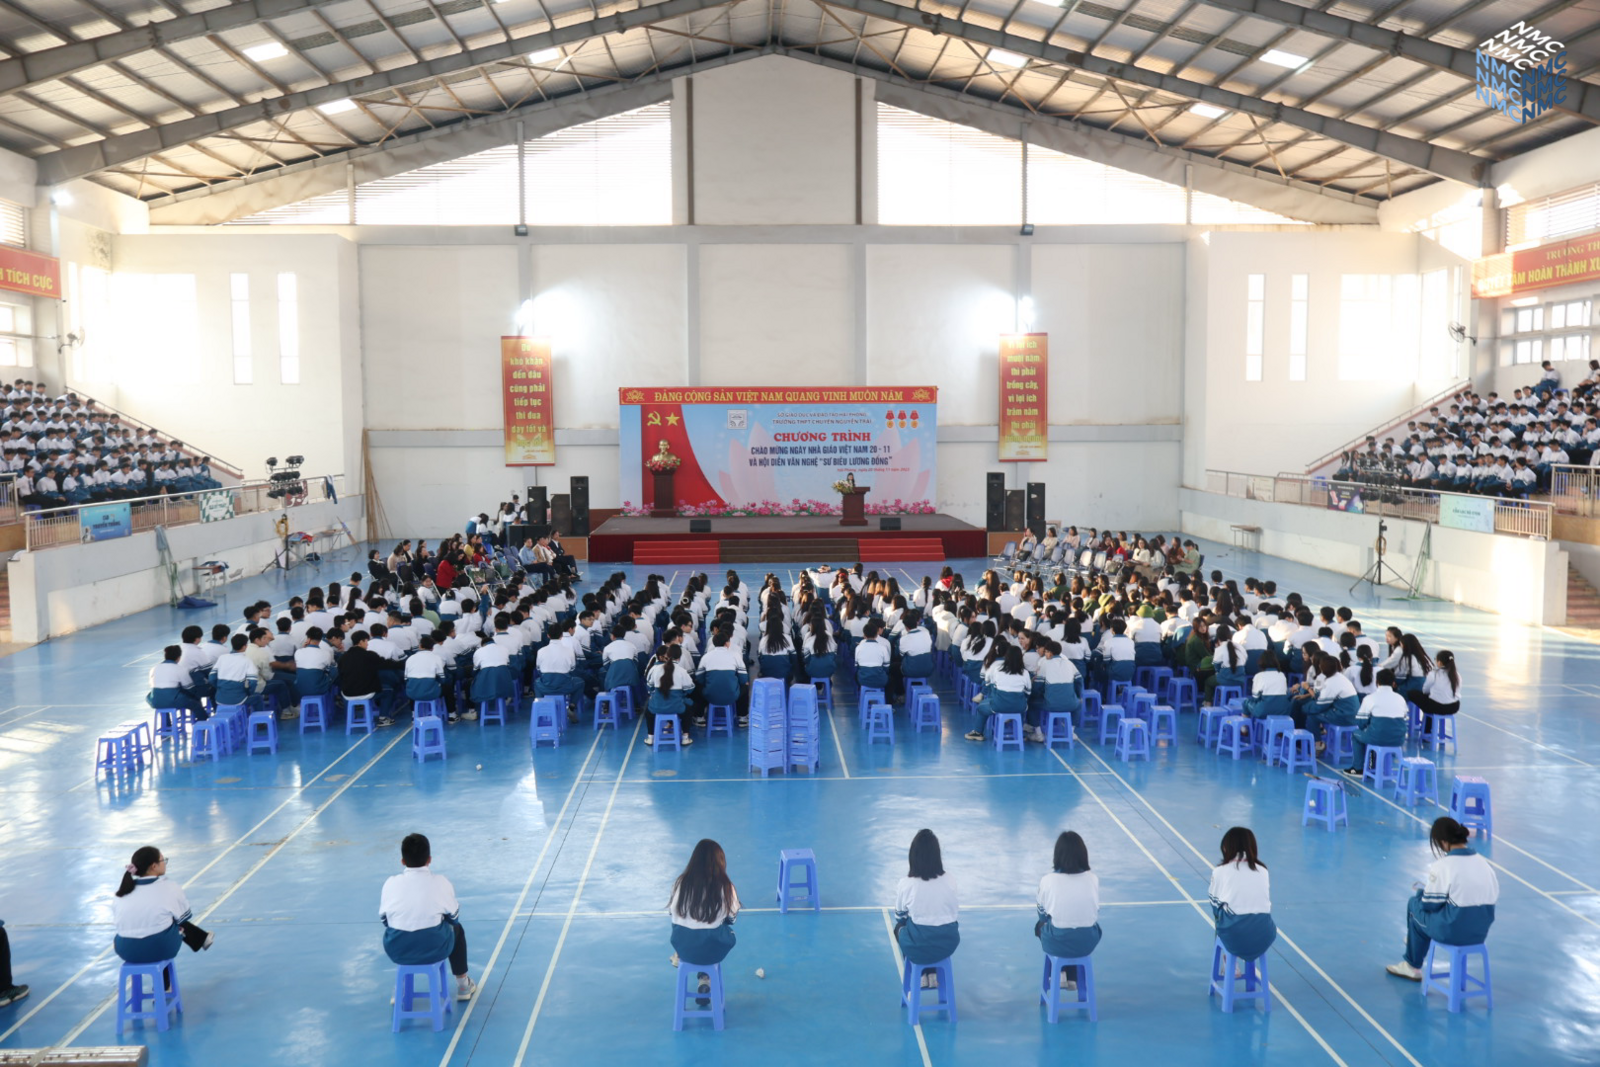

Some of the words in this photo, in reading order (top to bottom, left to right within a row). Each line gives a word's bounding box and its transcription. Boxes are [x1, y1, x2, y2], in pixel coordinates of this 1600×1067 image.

[1528, 264, 1553, 283] HOÀN
[1556, 260, 1586, 278] THÀNH
[6, 267, 30, 285] TÍCH
[32, 274, 53, 292] CỰC
[512, 370, 526, 379] đến
[1021, 366, 1036, 376] phải
[510, 384, 528, 394] cũng
[529, 383, 545, 393] phải
[514, 396, 528, 406] tiếp
[530, 398, 542, 407] tục
[654, 390, 682, 402] ĐẢNG
[684, 390, 711, 403] CỘNG
[714, 390, 733, 401] SẢN
[736, 390, 759, 403] VIỆT
[761, 392, 783, 401] NAM
[786, 392, 820, 402] QUANG
[822, 391, 847, 401] VINH
[850, 390, 878, 400] MUÔN
[881, 390, 903, 400] NĂM
[1026, 394, 1037, 402] ích
[528, 411, 541, 419] đua
[774, 431, 827, 442] CHƯƠNG
[832, 430, 871, 441] TRÌNH
[751, 446, 768, 455] CHÀO
[770, 445, 788, 454] MỪNG
[790, 445, 806, 454] NGÀY
[808, 445, 821, 454] NHÀ
[823, 445, 837, 454] GIÁO
[839, 445, 851, 455] VIỆT
[749, 458, 757, 466] VÀ
[759, 458, 769, 467] HỘI
[771, 457, 786, 466] DIỄN
[787, 457, 800, 466] VĂN
[802, 457, 818, 467] NGHỆ
[849, 457, 870, 465] LƯƠNG
